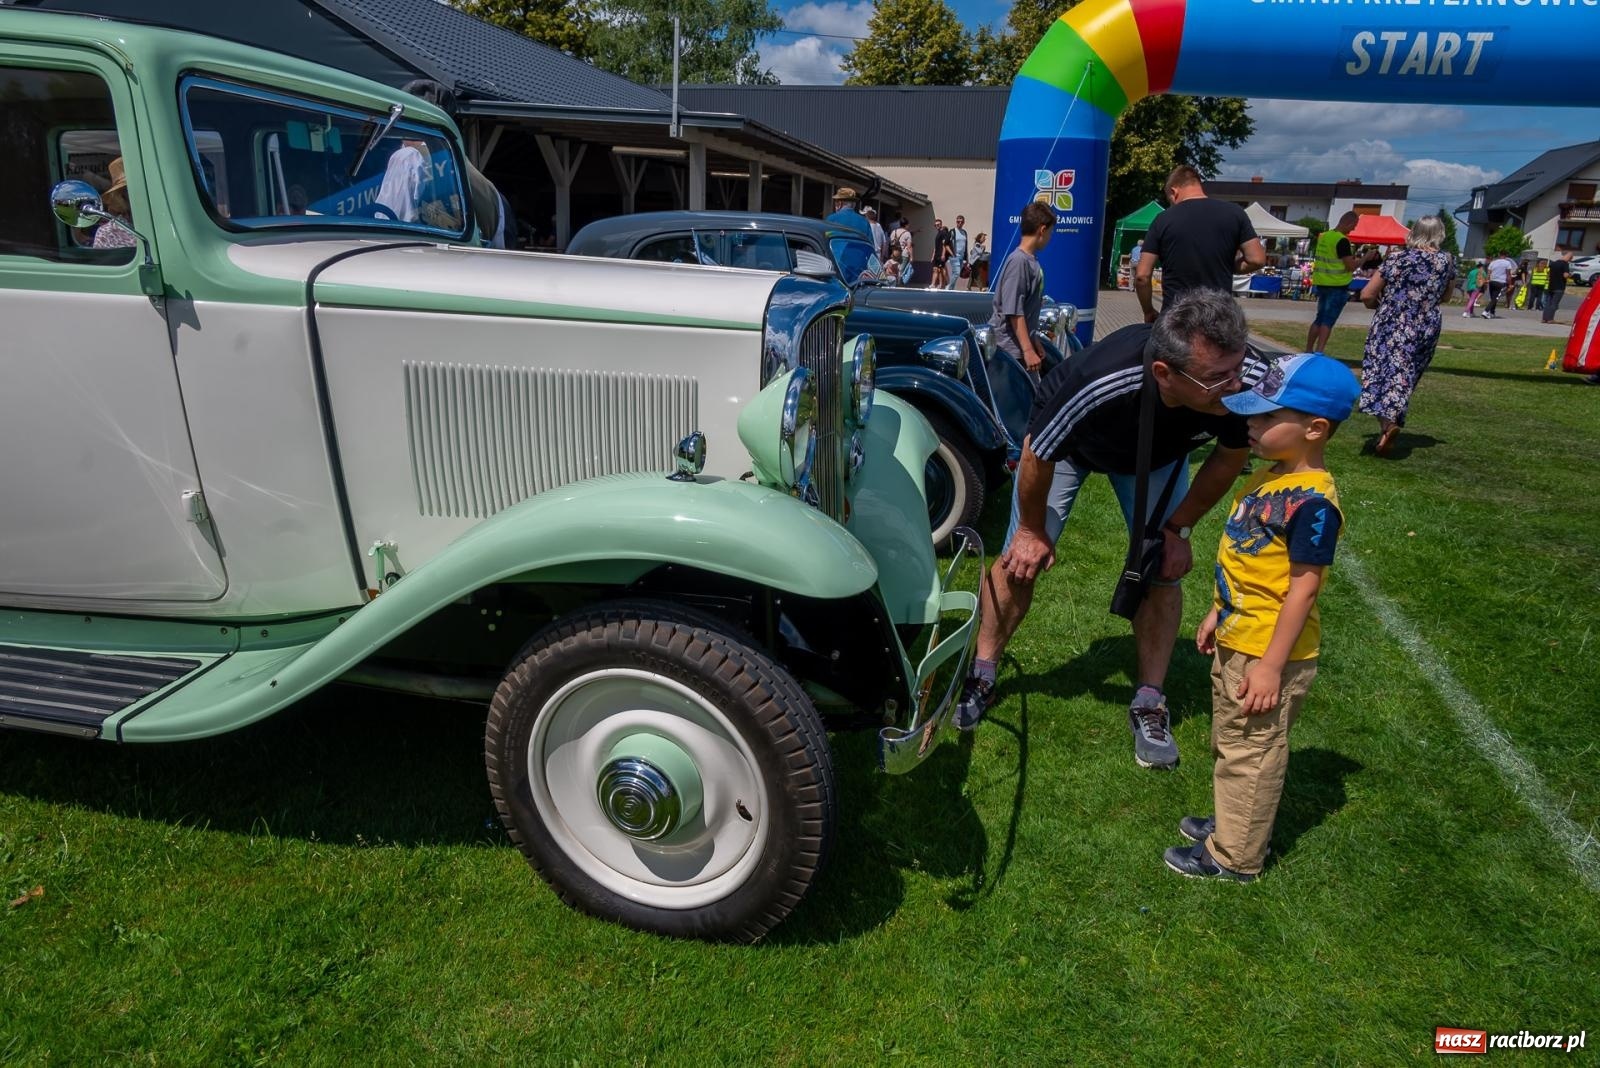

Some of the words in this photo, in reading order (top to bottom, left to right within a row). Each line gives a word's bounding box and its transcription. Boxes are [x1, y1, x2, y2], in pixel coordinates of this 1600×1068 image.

[1345, 30, 1494, 77] START
[1008, 215, 1022, 224] GMI
[1056, 214, 1094, 225] ŻANOWICE
